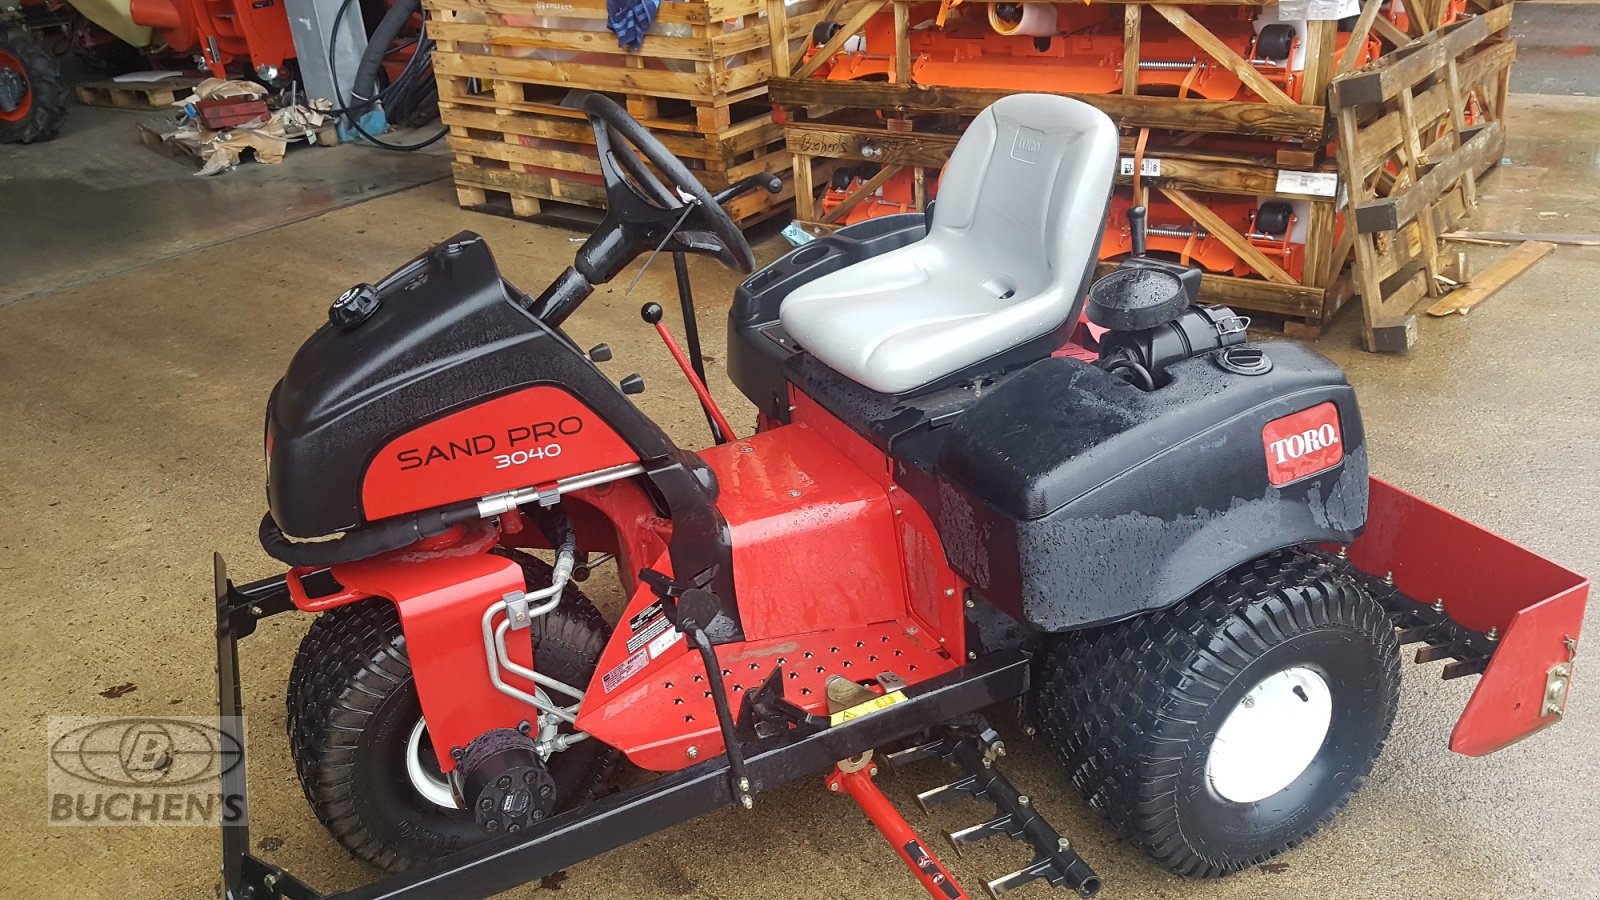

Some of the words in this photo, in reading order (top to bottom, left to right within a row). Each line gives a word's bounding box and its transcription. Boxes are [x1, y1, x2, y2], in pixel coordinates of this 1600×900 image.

[397, 434, 496, 471] SAND
[507, 415, 583, 447] PRO
[494, 443, 561, 469] 3040
